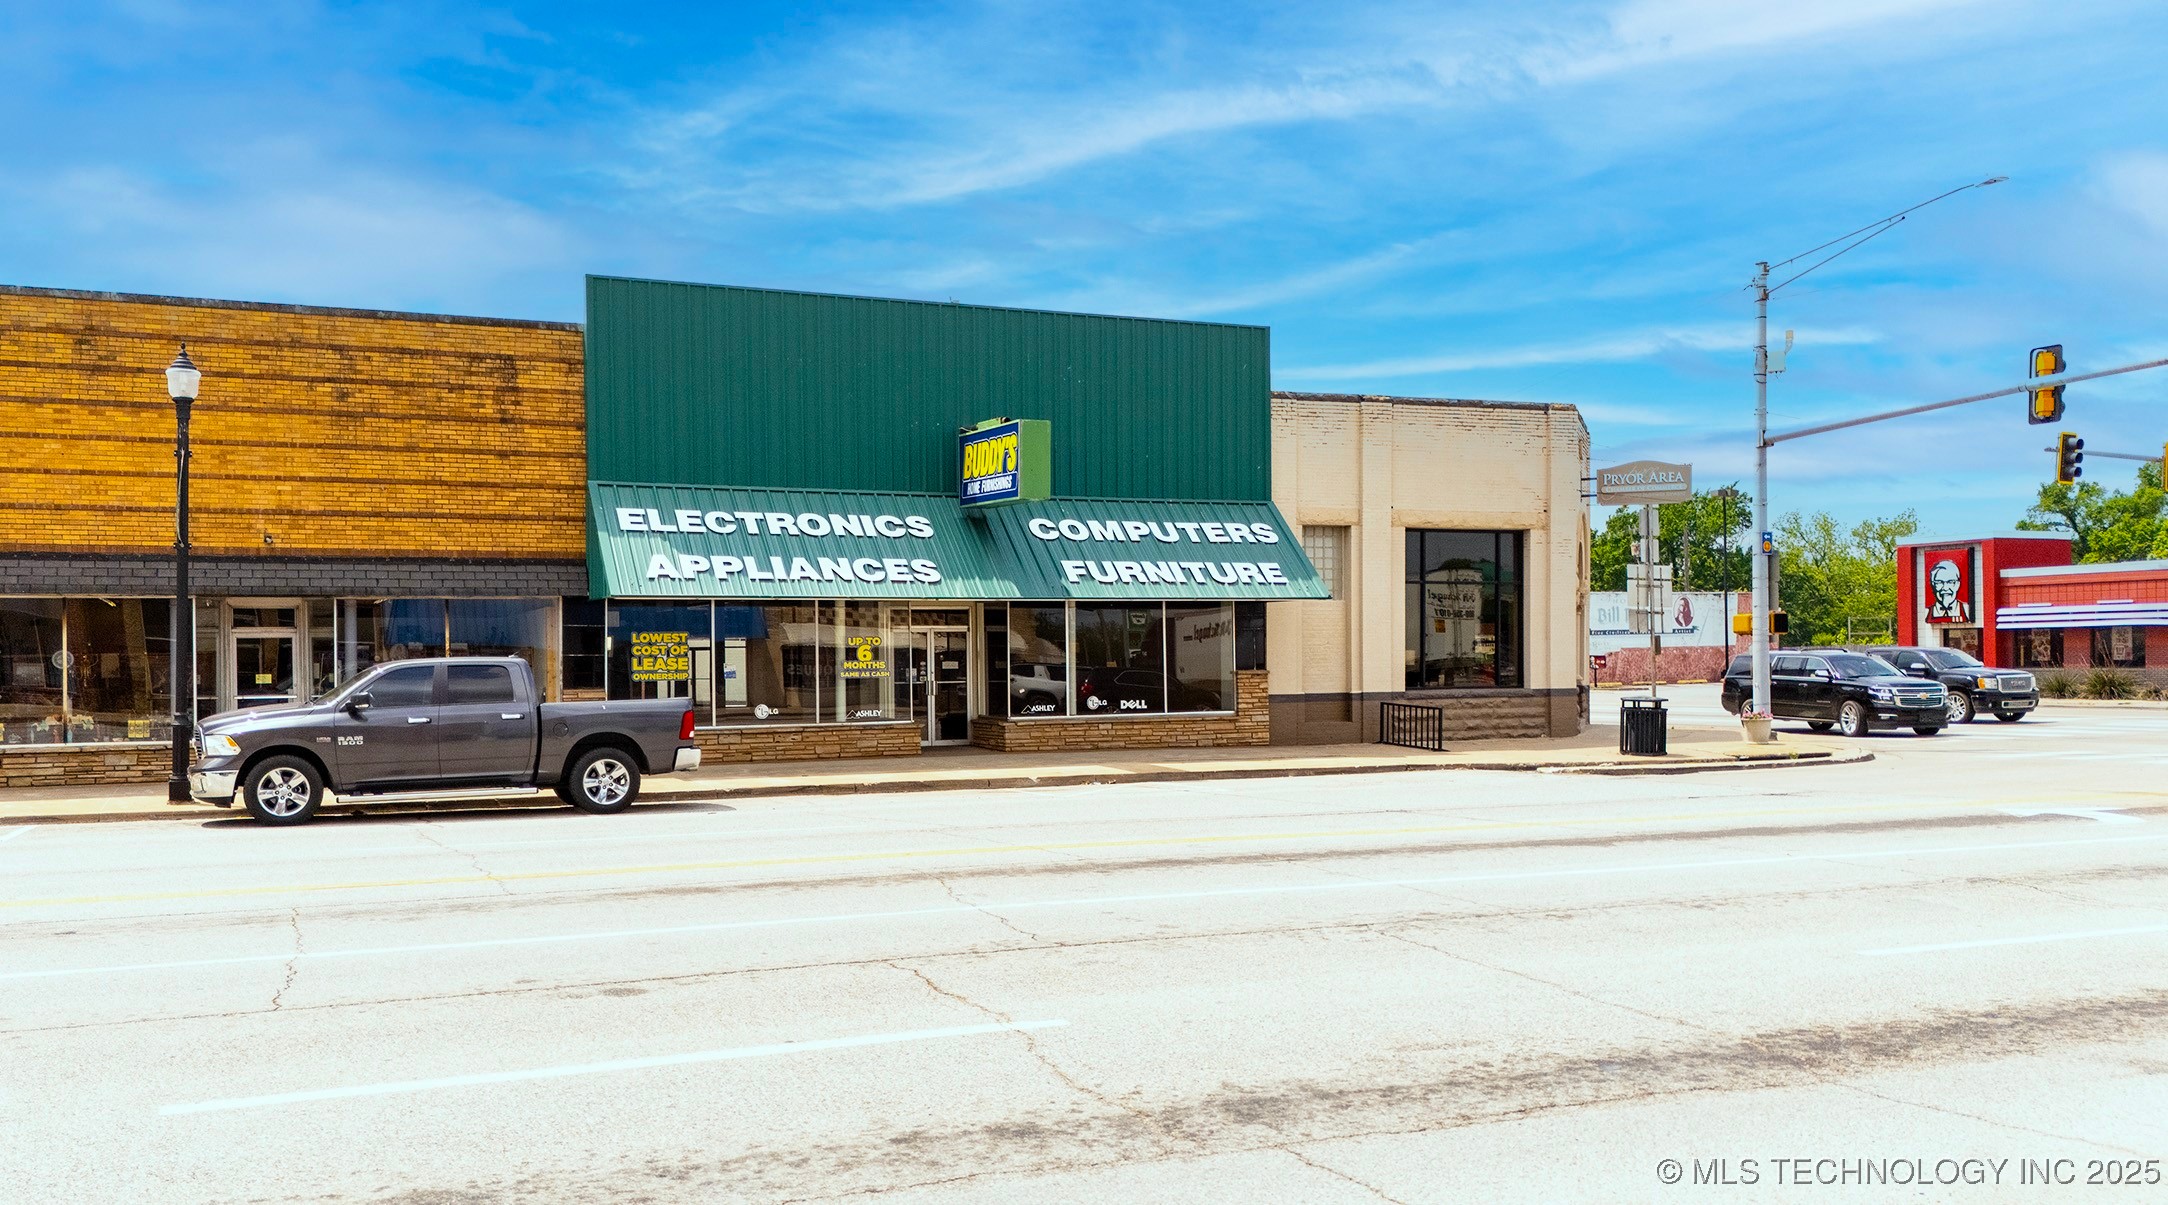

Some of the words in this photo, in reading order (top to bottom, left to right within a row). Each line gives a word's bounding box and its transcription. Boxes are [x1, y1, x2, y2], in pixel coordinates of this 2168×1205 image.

[963, 433, 1018, 480] BUDDY'S
[1603, 473, 1645, 486] PRYOR
[1648, 472, 1684, 483] AREA
[615, 507, 935, 539] ELECTRONICS
[1028, 518, 1280, 545] COMPUTERS
[646, 553, 942, 584] APPLIANCES
[1060, 560, 1289, 585] FURNITURE
[1598, 606, 1620, 624] Bill
[632, 633, 688, 643] LOWEST
[847, 637, 864, 645] UP
[866, 637, 881, 646] TO
[632, 645, 667, 656] COST
[670, 645, 689, 655] OF
[857, 644, 873, 661] 6
[632, 657, 689, 670] LEASE
[843, 661, 886, 669] MONTHS
[1031, 704, 1056, 712] ASHLEY
[1120, 700, 1148, 710] DELL
[856, 709, 882, 717] ASHLEY
